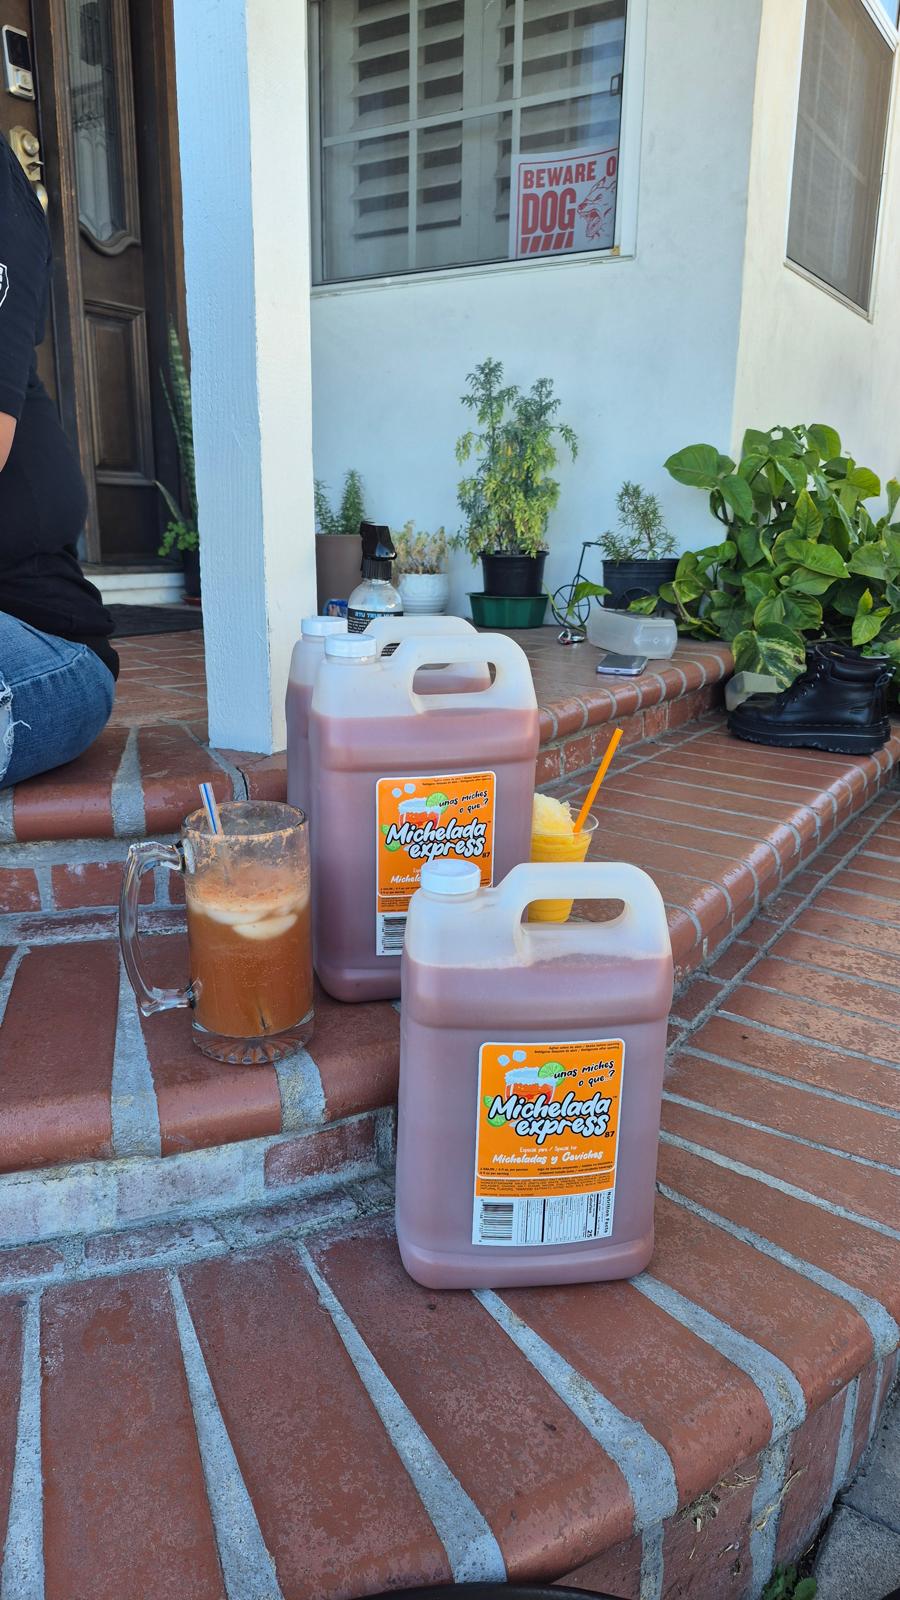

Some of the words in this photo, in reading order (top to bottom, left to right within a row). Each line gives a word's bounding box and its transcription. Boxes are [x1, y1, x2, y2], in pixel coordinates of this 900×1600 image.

[523, 161, 597, 189] BEWARE
[521, 188, 577, 235] DOG
[439, 798, 458, 808] unas
[461, 790, 488, 802] miches
[467, 803, 481, 813] que
[385, 817, 487, 845] Michelada
[408, 836, 486, 862] express
[553, 1068, 578, 1079] unas
[581, 1060, 614, 1074] miches
[578, 1079, 584, 1087] o
[588, 1075, 605, 1087] que
[488, 1091, 613, 1120] Michelada
[515, 1114, 610, 1145] express
[492, 1153, 547, 1165] Micheladas
[550, 1154, 558, 1165] y
[562, 1150, 603, 1162] Ceviches
